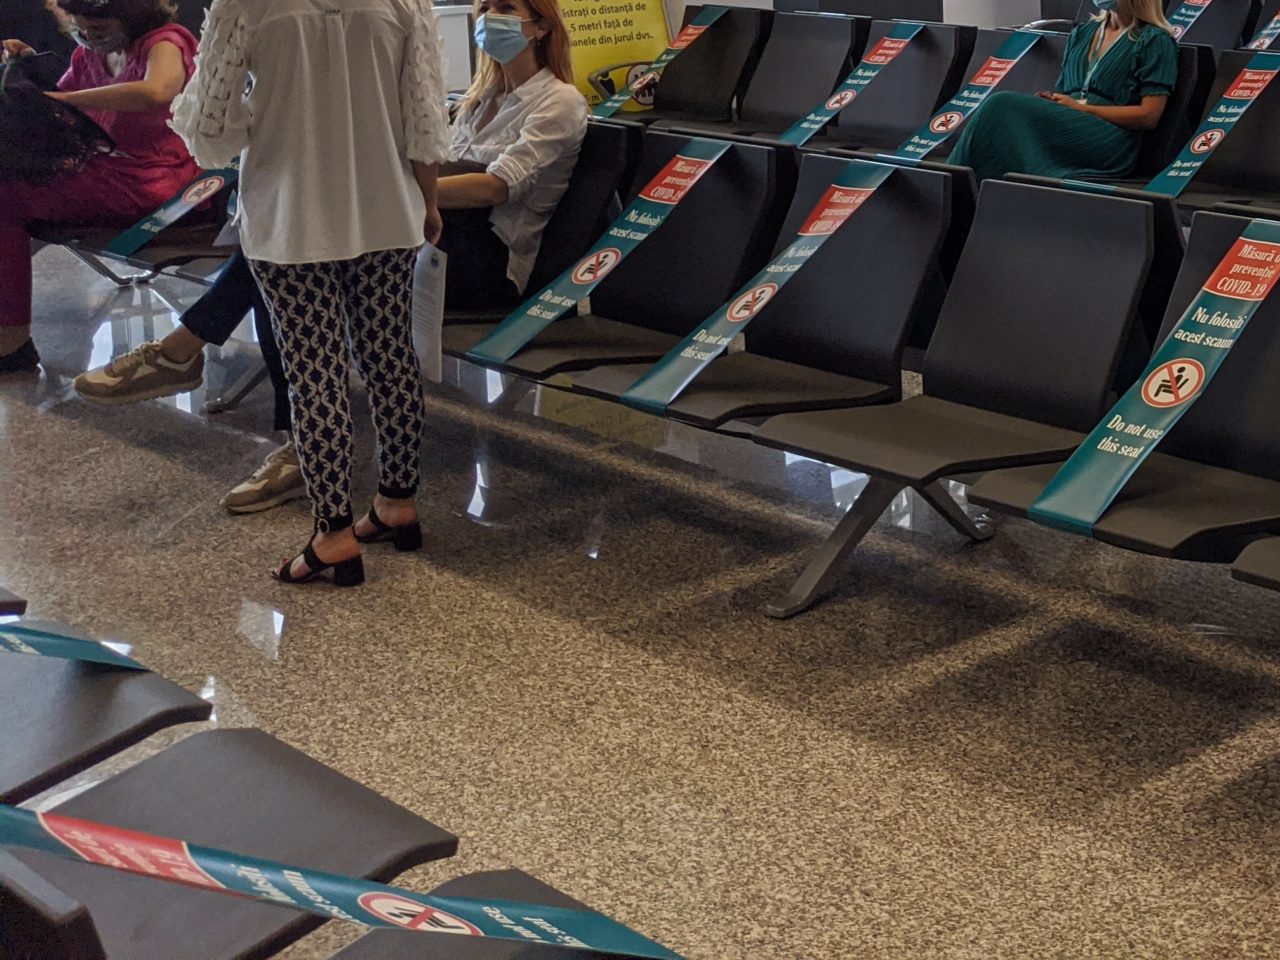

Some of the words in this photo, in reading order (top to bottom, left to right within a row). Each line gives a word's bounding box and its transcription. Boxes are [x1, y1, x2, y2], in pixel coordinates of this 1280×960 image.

[598, 3, 633, 16] distanță
[635, 2, 646, 11] de
[578, 20, 602, 32] metri
[604, 18, 620, 31] față
[622, 17, 633, 27] de
[599, 34, 612, 45] din
[614, 32, 634, 45] jurul
[636, 31, 654, 41] dvs.
[1238, 243, 1276, 262] Măsură
[1229, 263, 1276, 281] prevenție
[1216, 276, 1268, 297] COVID-19
[1191, 306, 1208, 324] Nu
[1209, 311, 1248, 332] folosiți
[1174, 327, 1204, 344] acest
[1205, 335, 1235, 349] scaun
[1106, 414, 1124, 431] Do
[1125, 422, 1146, 436] not
[1147, 428, 1164, 440] use
[1097, 435, 1119, 454] this
[1118, 443, 1144, 459] seat
